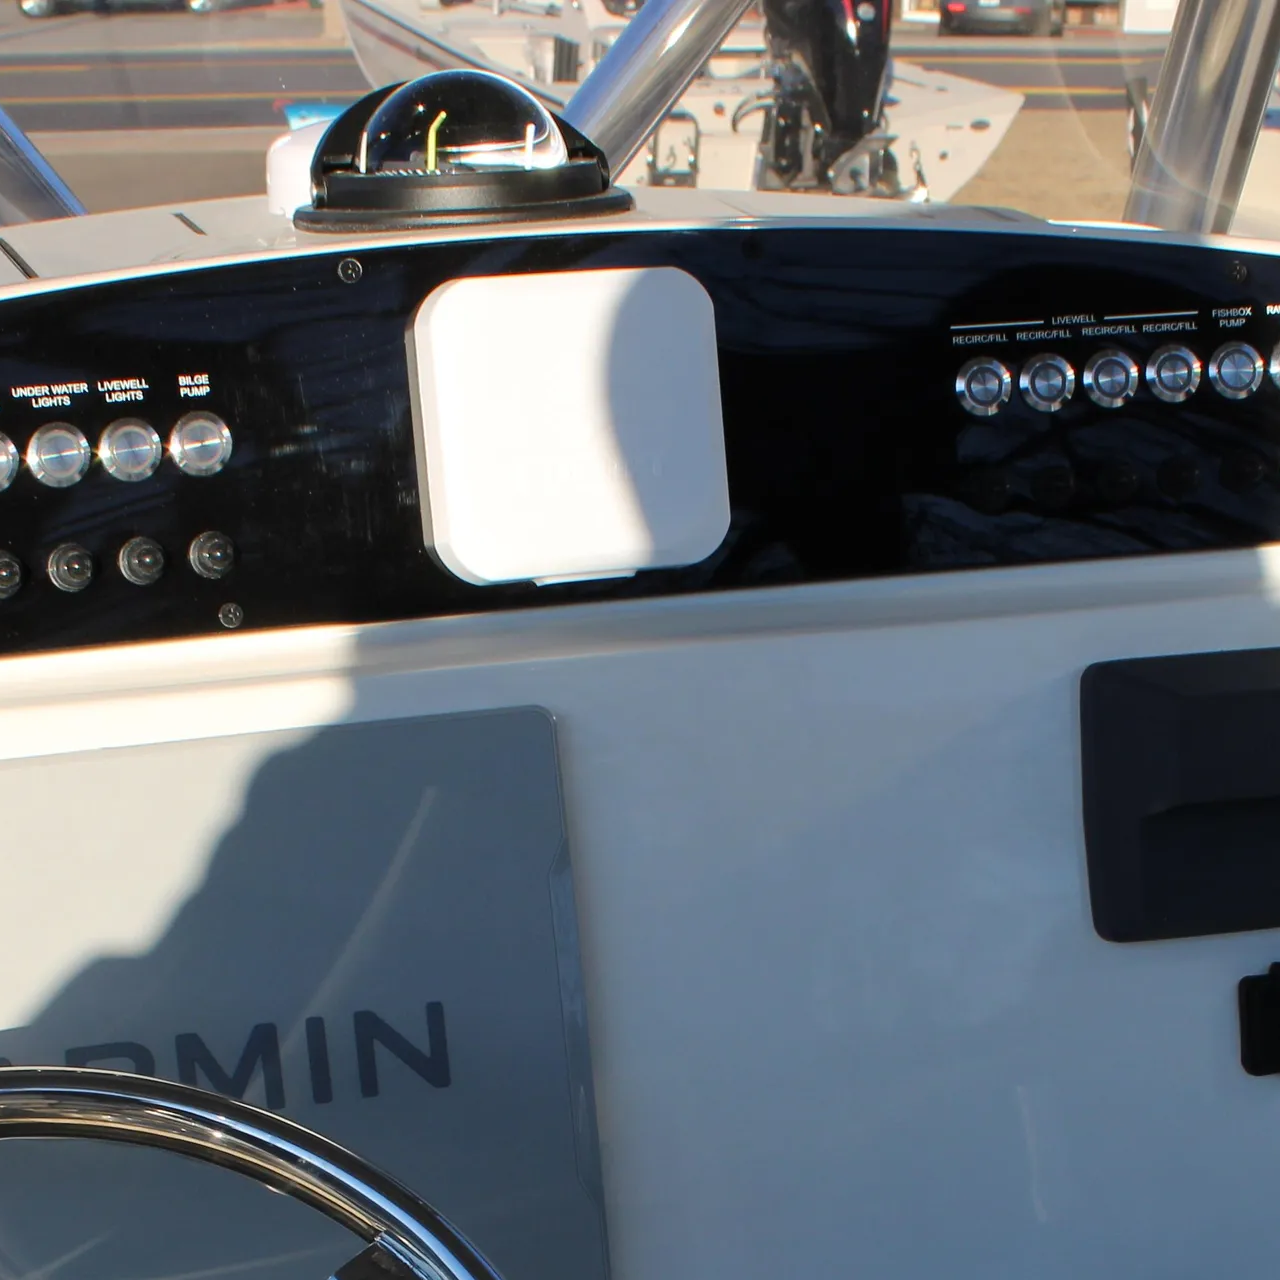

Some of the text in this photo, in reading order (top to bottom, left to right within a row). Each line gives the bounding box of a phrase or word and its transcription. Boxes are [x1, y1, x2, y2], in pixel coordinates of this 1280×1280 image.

[1212, 306, 1252, 318] FISHBOX
[1052, 313, 1096, 326] LIVEWELL
[1219, 318, 1246, 328] PUMP
[1081, 323, 1137, 337] RECIRC/FILL
[1142, 320, 1198, 333] RECIRC/FILL
[952, 332, 1009, 345] RECIRC/FILL
[1016, 329, 1072, 341] RECIRC/FILL
[97, 378, 149, 393] LIVEWELL
[178, 374, 210, 387] BILGE
[12, 382, 89, 398] UNDER WATER
[105, 389, 144, 403] LIGHTS
[180, 385, 210, 398] PUMP
[31, 395, 71, 409] LIGHTS
